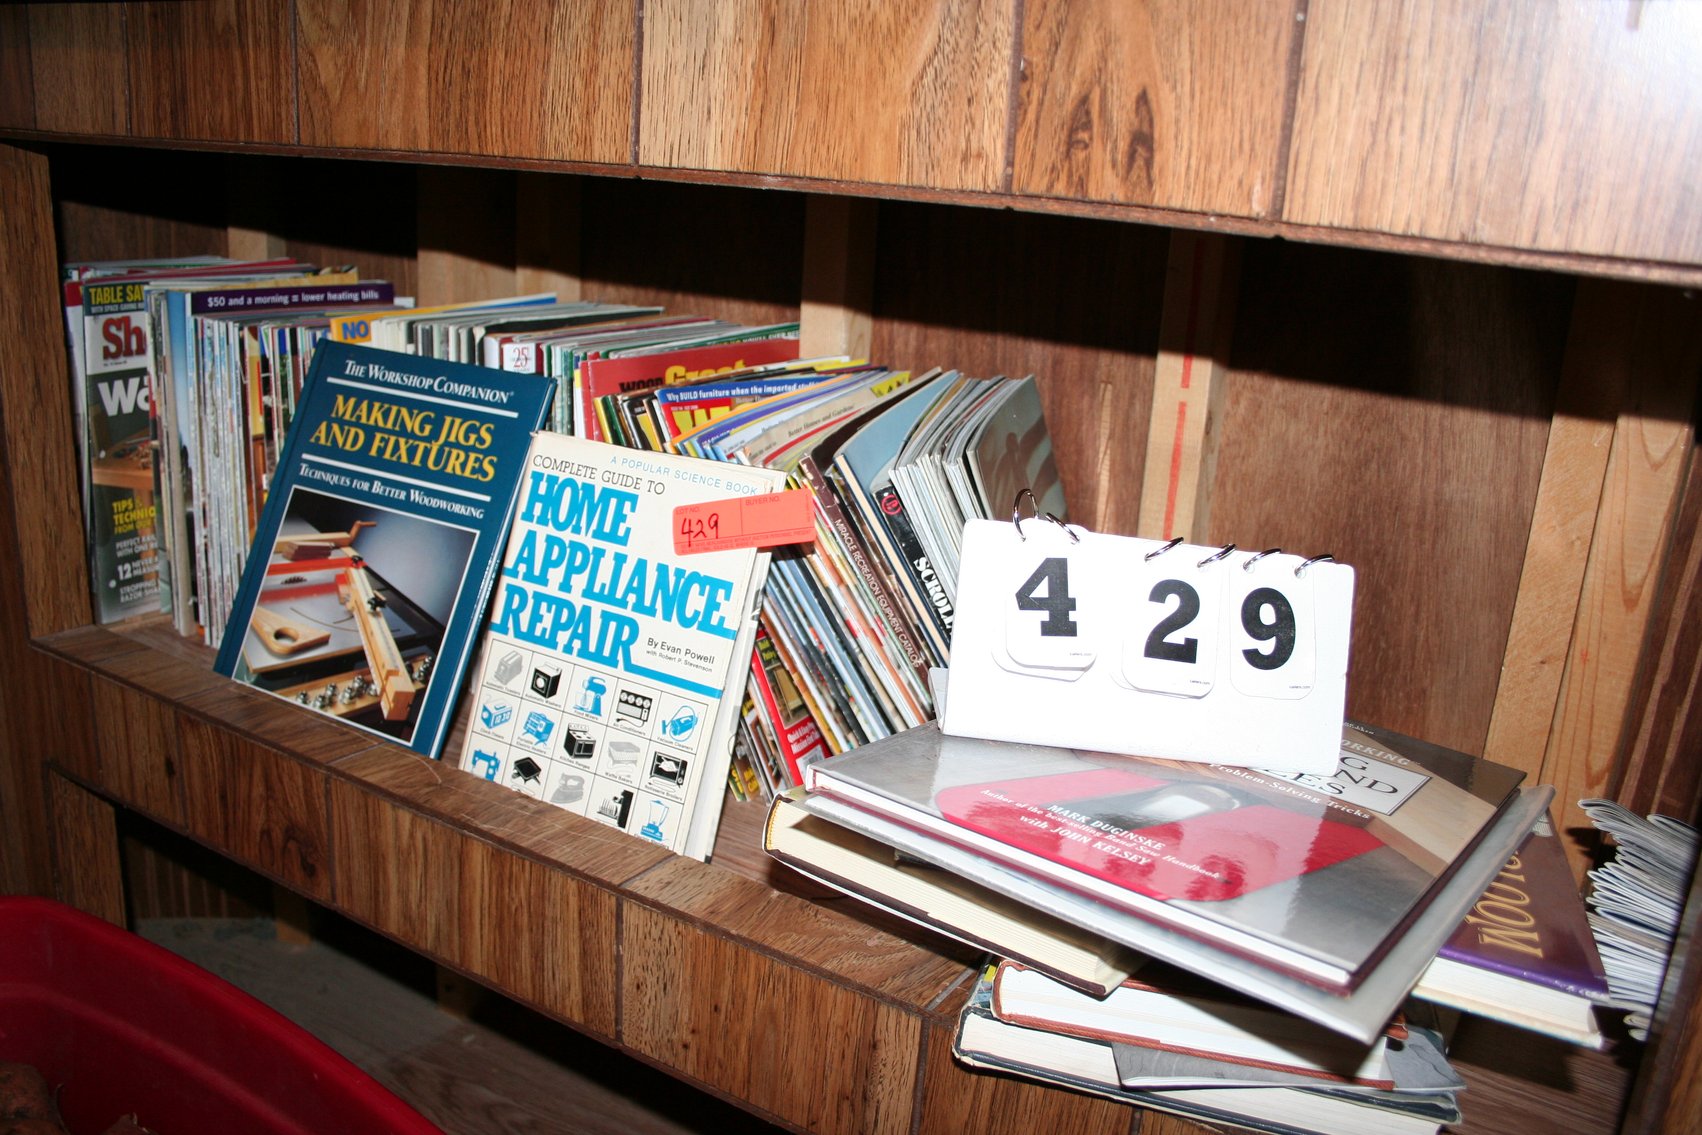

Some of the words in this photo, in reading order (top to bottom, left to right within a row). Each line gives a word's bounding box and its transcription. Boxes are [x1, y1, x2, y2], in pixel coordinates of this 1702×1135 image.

[89, 286, 123, 305] TABLE
[207, 296, 226, 307] $50
[228, 295, 244, 306] and
[247, 297, 252, 305] a
[255, 293, 289, 305] morning
[301, 292, 325, 302] lower
[326, 291, 359, 302] heating
[361, 290, 379, 300] bills
[102, 315, 147, 360] Sh
[513, 347, 529, 368] 25
[366, 363, 433, 390] WORKSHOP
[666, 392, 679, 402] Why
[680, 391, 698, 400] BUILD
[699, 389, 729, 399] furniture
[731, 387, 749, 396] when
[751, 386, 763, 394] the
[763, 383, 796, 394] imported
[331, 395, 434, 436] MAKING
[430, 415, 495, 450] JIGS
[310, 421, 365, 451] AND
[368, 432, 497, 482] FIXTURES
[299, 463, 351, 487] TECHNIQUES
[371, 481, 407, 501] BETTER
[409, 489, 485, 519] WOODWORKING
[532, 454, 596, 480] COMPLETE
[601, 470, 641, 490] GUIDE
[646, 481, 666, 495] TO
[610, 456, 617, 465] A
[621, 457, 670, 477] POPULAR
[673, 469, 722, 489] SCIENCE
[726, 480, 758, 496] BOOK
[112, 497, 133, 513] TIPS
[113, 506, 156, 525] TECHNIQ
[520, 470, 639, 546] HOME
[681, 513, 719, 547] 429
[117, 563, 132, 580] 12
[502, 530, 737, 640] APPLIANCE
[835, 518, 857, 554] MIRACLE
[852, 550, 881, 599] RECREATION
[876, 593, 905, 638] EQUIPMENT
[897, 631, 922, 668] CATALOG
[488, 583, 640, 672] REPAIR
[1015, 557, 1078, 637] 4
[1144, 579, 1201, 664] 2
[1240, 587, 1296, 670] 9
[647, 637, 658, 649] By
[660, 641, 682, 654] Evan
[684, 648, 715, 664] Powell
[658, 652, 676, 662] Robert
[684, 660, 713, 672] Stevenson
[1333, 769, 1398, 794] ND
[1047, 804, 1091, 824] MARK
[1089, 819, 1166, 851] DUGINSKE
[1327, 799, 1371, 819] Tricks
[980, 789, 1014, 803] Author
[1027, 805, 1044, 815] the
[1104, 833, 1136, 848] Band
[1135, 844, 1160, 857] Saw
[1162, 854, 1220, 879] Handbook
[1019, 815, 1049, 829] with
[1050, 827, 1093, 845] JOHN
[1092, 840, 1153, 865] KELSEY
